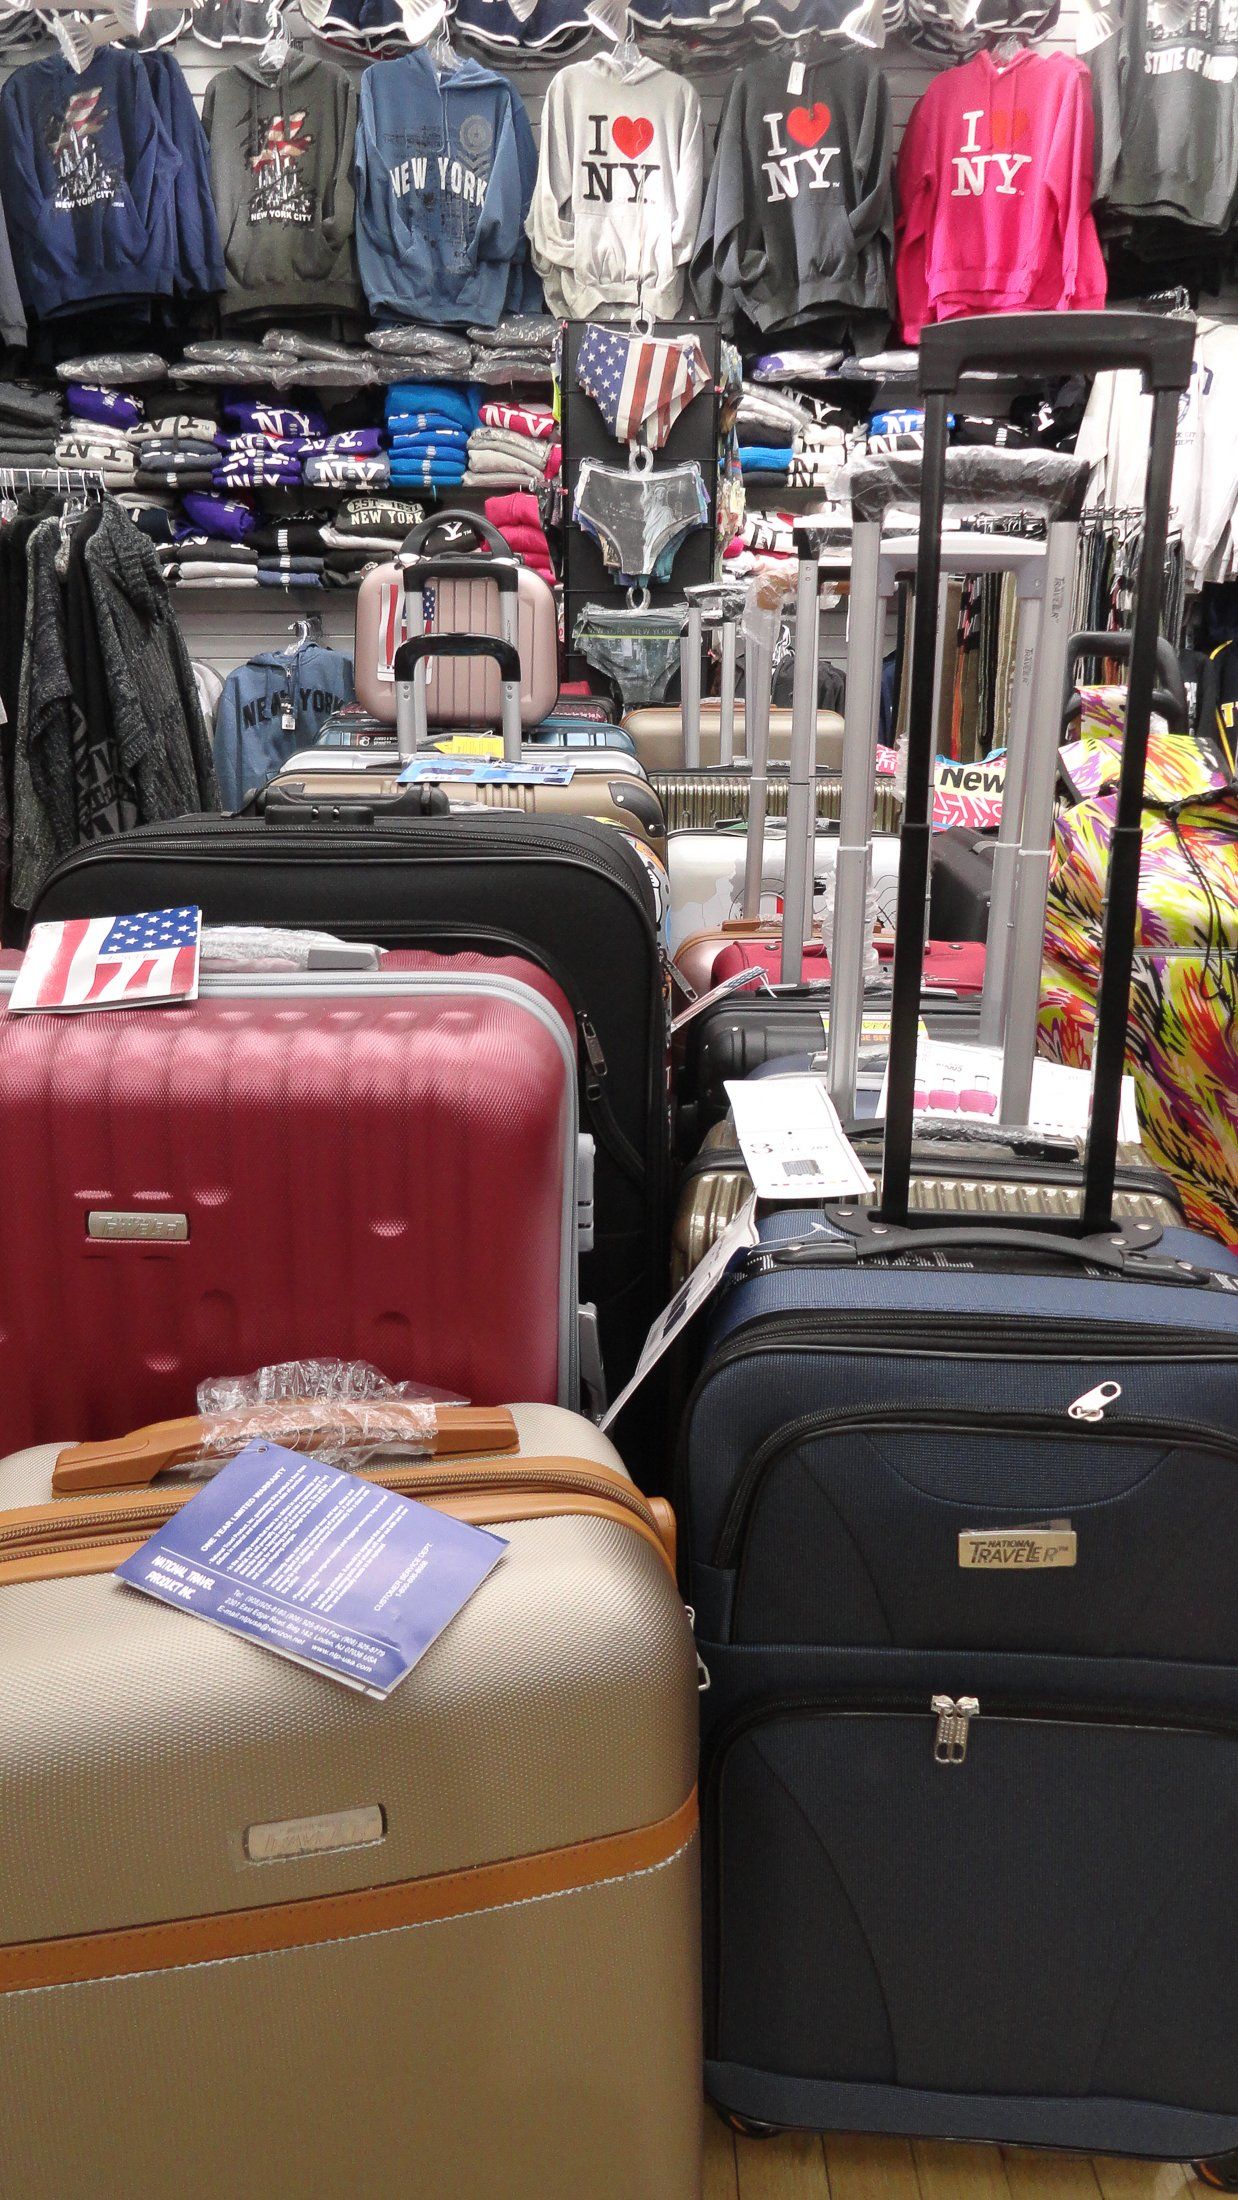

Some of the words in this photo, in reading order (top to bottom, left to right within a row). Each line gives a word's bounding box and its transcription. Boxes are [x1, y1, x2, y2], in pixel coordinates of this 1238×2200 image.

[1186, 48, 1205, 73] OF
[588, 114, 608, 156] I
[763, 112, 787, 157] I
[960, 110, 985, 153] I
[389, 157, 428, 199] NEW
[438, 157, 488, 207] YORK
[581, 161, 661, 203] NY
[762, 147, 841, 203] NY
[951, 153, 1033, 196] NY
[54, 200, 75, 209] NEW
[95, 188, 115, 199] CITY
[250, 210, 268, 221] NEW
[269, 209, 293, 220] YORK
[293, 212, 312, 221] CITY
[251, 409, 317, 438] NY
[350, 509, 382, 526] NEW
[387, 510, 424, 525] YORK
[200, 1537, 218, 1552] ONE
[213, 1520, 234, 1538] YEAR
[230, 1497, 256, 1522] LIMITED
[252, 1466, 286, 1498] WARRANTY
[968, 1541, 1059, 1563] TRAVELER
[145, 1570, 184, 1593] PRODUCT
[151, 1555, 188, 1579] NATIONAL
[185, 1570, 216, 1591] TRAVEL
[374, 1579, 403, 1611] CUSTOMER
[399, 1556, 422, 1581] SERVICE
[311, 1644, 372, 1673] www.ntp-usa.com
